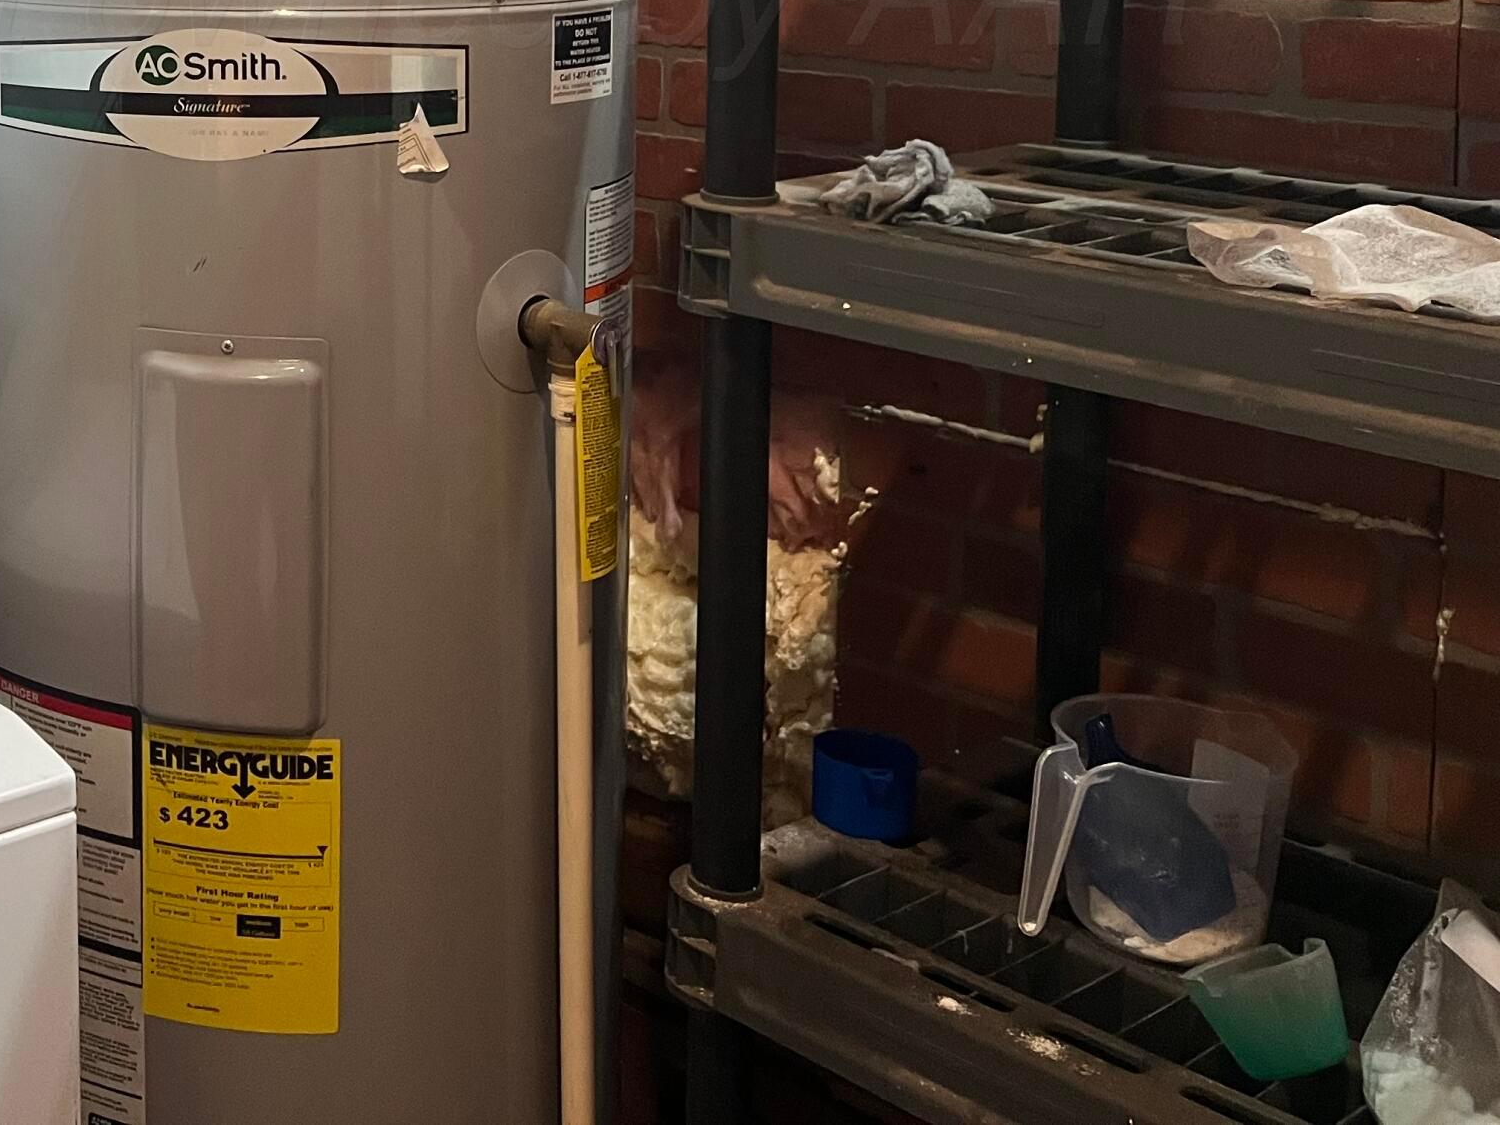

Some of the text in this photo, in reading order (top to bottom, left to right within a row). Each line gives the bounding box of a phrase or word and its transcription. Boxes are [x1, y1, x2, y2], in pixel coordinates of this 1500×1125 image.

[562, 19, 573, 27] YOU
[575, 27, 598, 37] DO NOT
[138, 51, 182, 79] AO
[560, 73, 572, 82] Call
[0, 680, 40, 704] DANGER
[150, 740, 334, 780] ENERGYGUIDE
[173, 790, 279, 809] Estimated Yearly Energy Cost
[177, 805, 229, 830] 423
[196, 885, 279, 902] First Hour Rating
